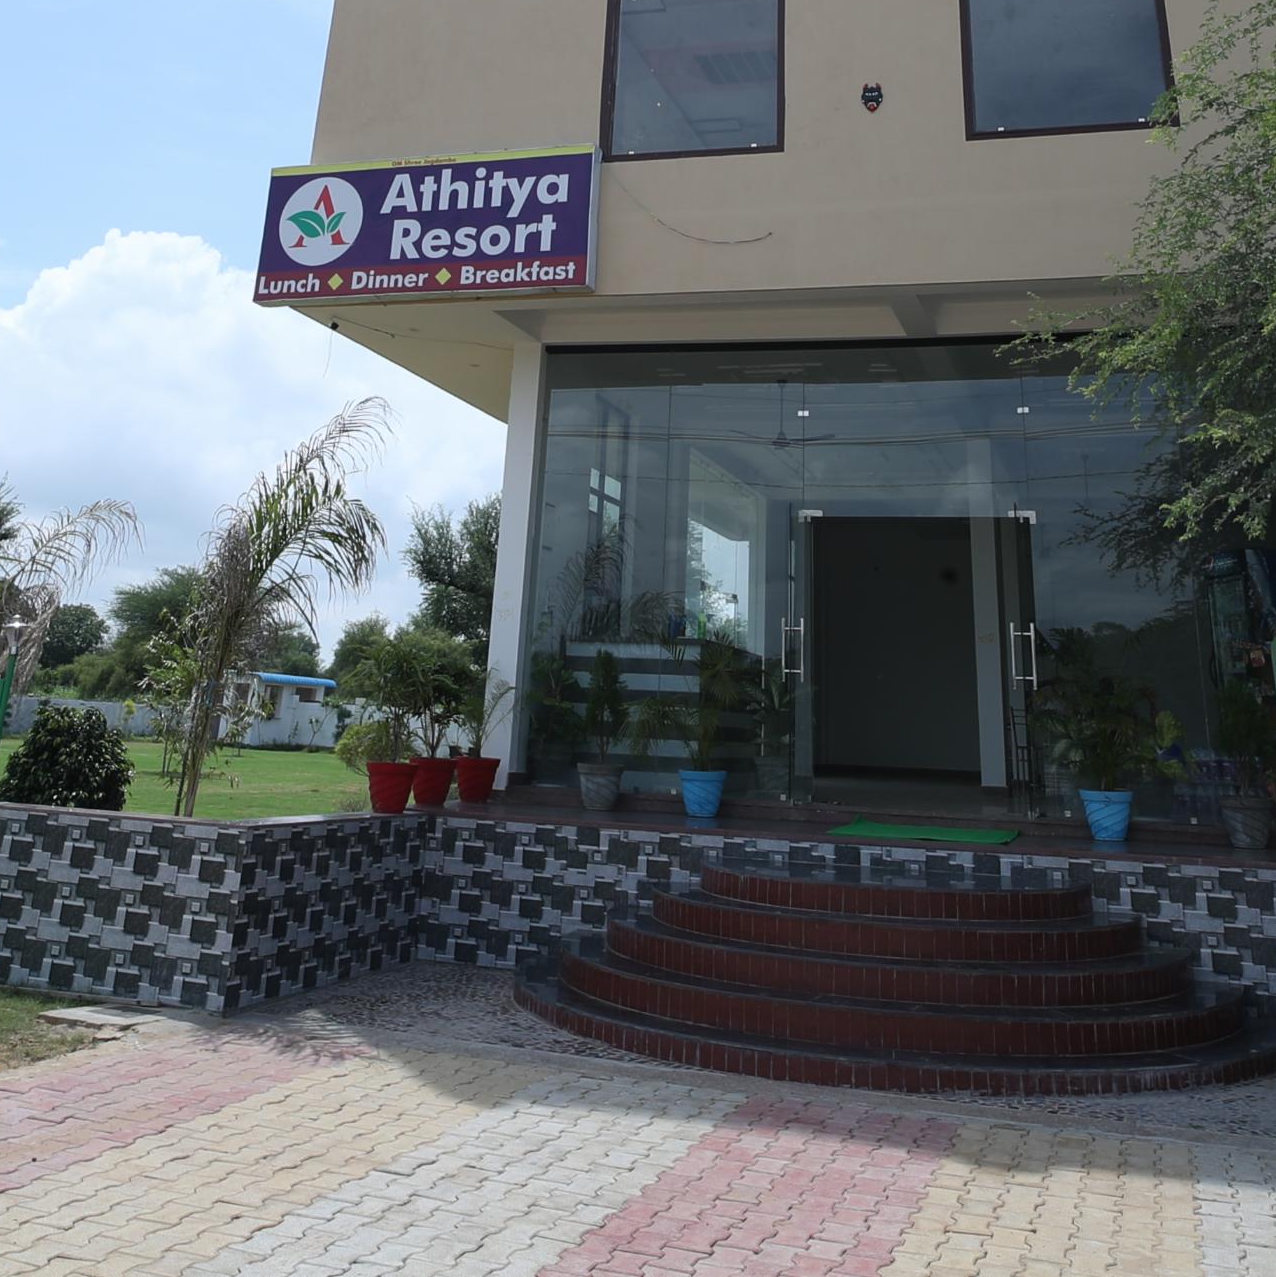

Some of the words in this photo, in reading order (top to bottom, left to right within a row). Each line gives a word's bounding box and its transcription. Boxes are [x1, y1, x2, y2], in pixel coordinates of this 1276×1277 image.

[379, 167, 569, 218] Athitya
[389, 214, 556, 260] Resort
[258, 273, 320, 294] Lunch
[351, 270, 429, 290] Dinner
[460, 261, 575, 284] Breakfast
